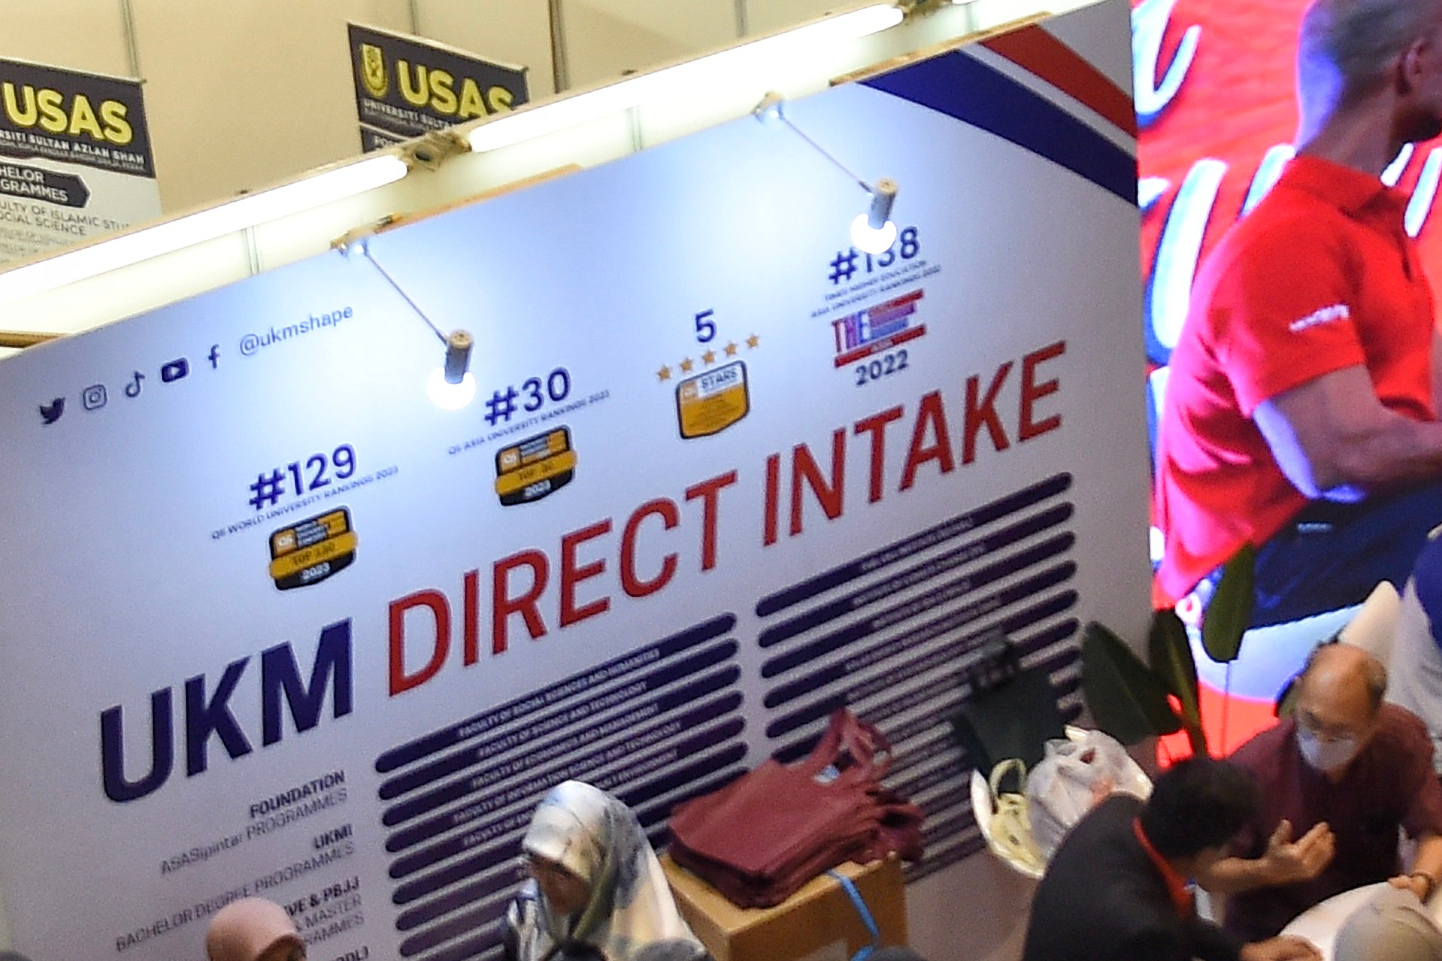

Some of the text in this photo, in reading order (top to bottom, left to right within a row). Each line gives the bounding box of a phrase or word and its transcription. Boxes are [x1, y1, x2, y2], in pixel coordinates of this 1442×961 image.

[2, 82, 133, 144] USAS
[364, 99, 418, 121] UNIVERSITI
[398, 59, 514, 119] USAS
[29, 132, 70, 150] SULTAN
[73, 142, 109, 158] AZLAN
[113, 149, 145, 164] SHAH
[31, 204, 46, 216] OF
[50, 209, 100, 228] ISLAMIC
[35, 217, 87, 236] SCIENCE
[240, 305, 354, 356] @ukmshape
[693, 309, 717, 343] 5
[832, 310, 869, 353] THE
[701, 368, 738, 389] STARS
[855, 349, 909, 386] 2022
[484, 366, 572, 427] #30
[464, 437, 486, 453] ASIA
[487, 415, 540, 443] UNIVERSITY
[541, 399, 587, 424] RANKINGS
[248, 442, 358, 510] #129
[228, 514, 265, 537] WORLD
[266, 495, 323, 522] UNIVERSITY
[324, 478, 374, 500] RANKINGS
[102, 618, 353, 803] UKM
[388, 469, 739, 697] DIRECT
[762, 341, 1068, 548] INTAKE
[300, 562, 331, 581] 2023
[246, 786, 348, 840] PROGRAMMES
[249, 770, 345, 819] FOUNDATION
[116, 840, 355, 952] BACHELOR DEGREE PROGRAMMES
[307, 892, 363, 929] MASTER
